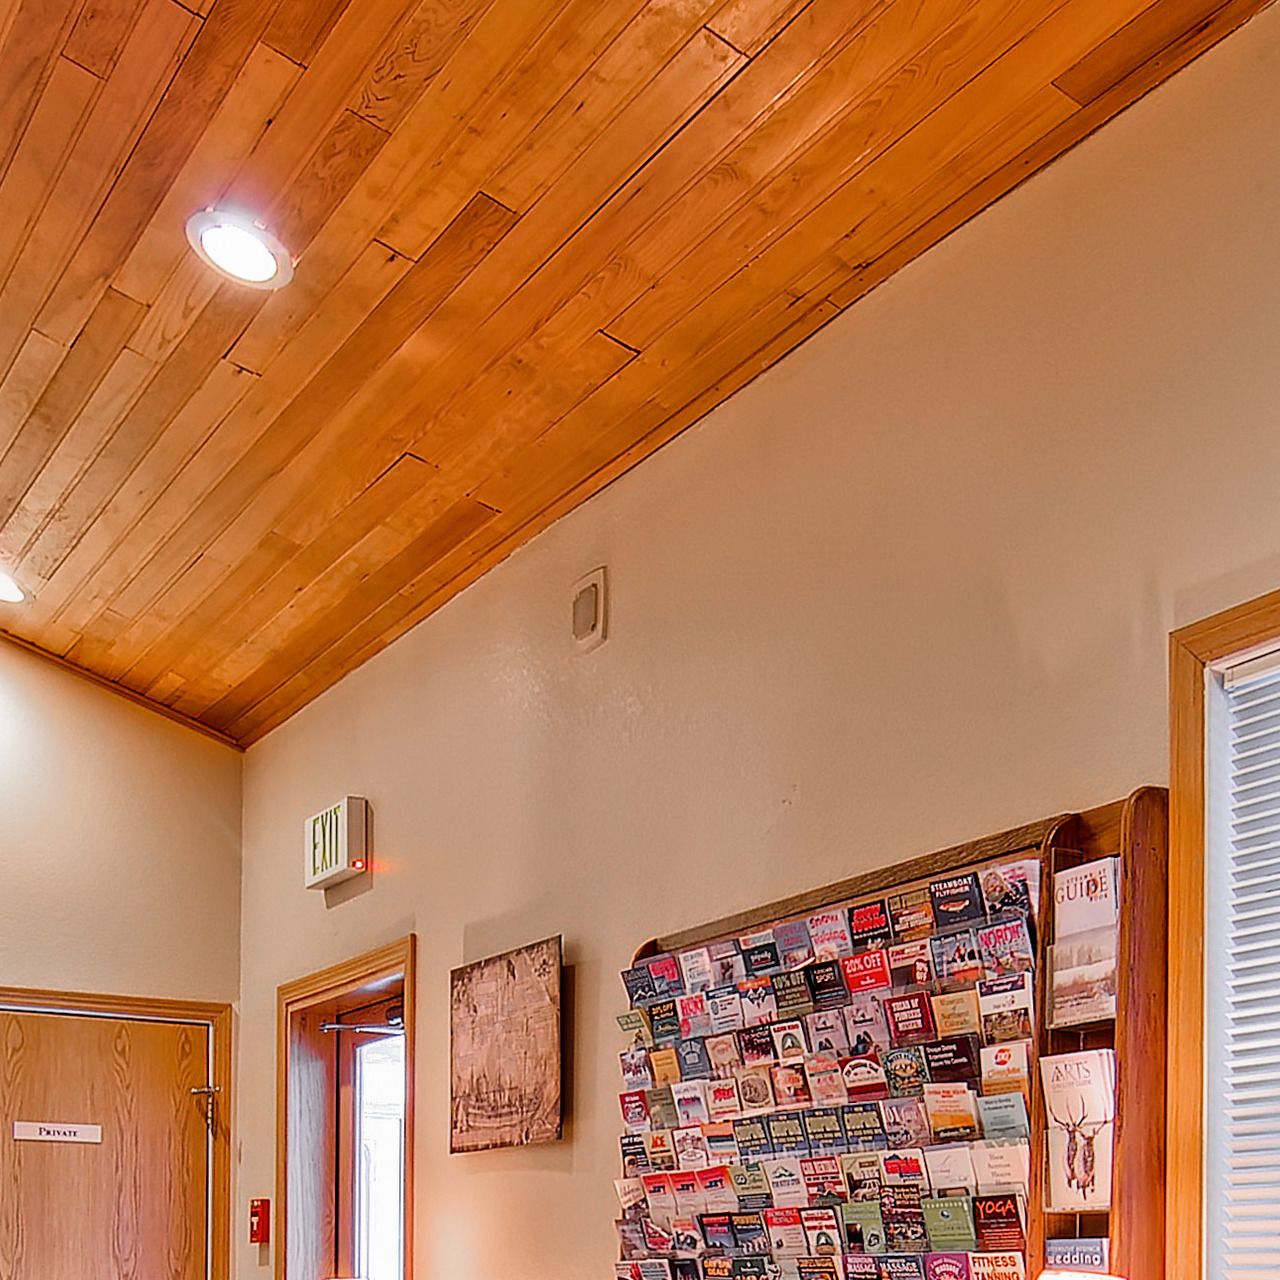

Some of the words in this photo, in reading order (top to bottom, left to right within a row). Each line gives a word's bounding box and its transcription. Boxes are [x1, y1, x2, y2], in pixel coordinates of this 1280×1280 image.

[312, 805, 341, 876] EXIT
[930, 877, 972, 892] STEAMBOAT
[1055, 875, 1109, 904] GUIDE
[845, 959, 864, 973] 20%
[863, 953, 882, 968] OFF
[789, 971, 805, 985] OFF
[1051, 1060, 1091, 1083] ARTS
[976, 1200, 1016, 1219] YOGA
[972, 1256, 1016, 1267] FITNESS
[1048, 1251, 1100, 1266] wedding
[880, 1262, 919, 1273] MASSAGE
